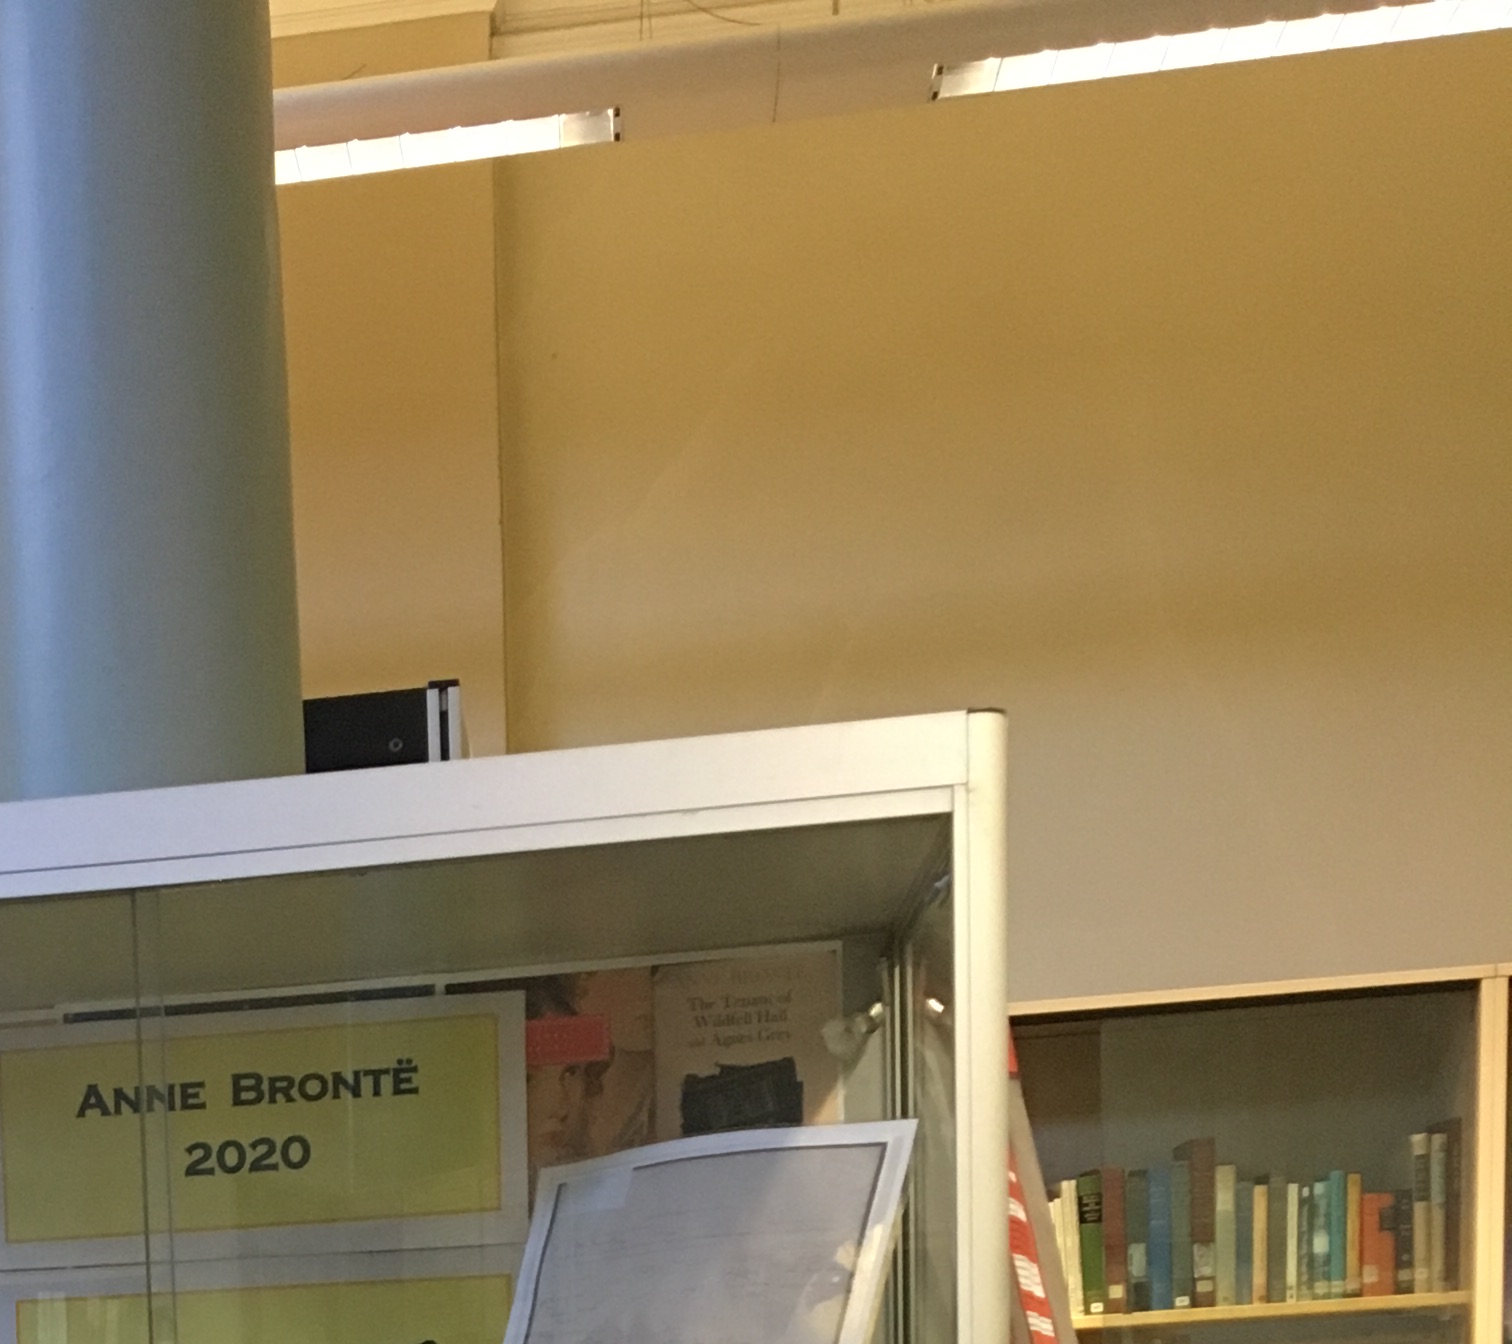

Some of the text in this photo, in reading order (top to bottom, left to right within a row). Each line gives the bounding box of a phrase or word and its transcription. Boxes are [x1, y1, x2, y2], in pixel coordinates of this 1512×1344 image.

[75, 1057, 420, 1119] ANNE BRONTË
[183, 1134, 311, 1178] 2020
